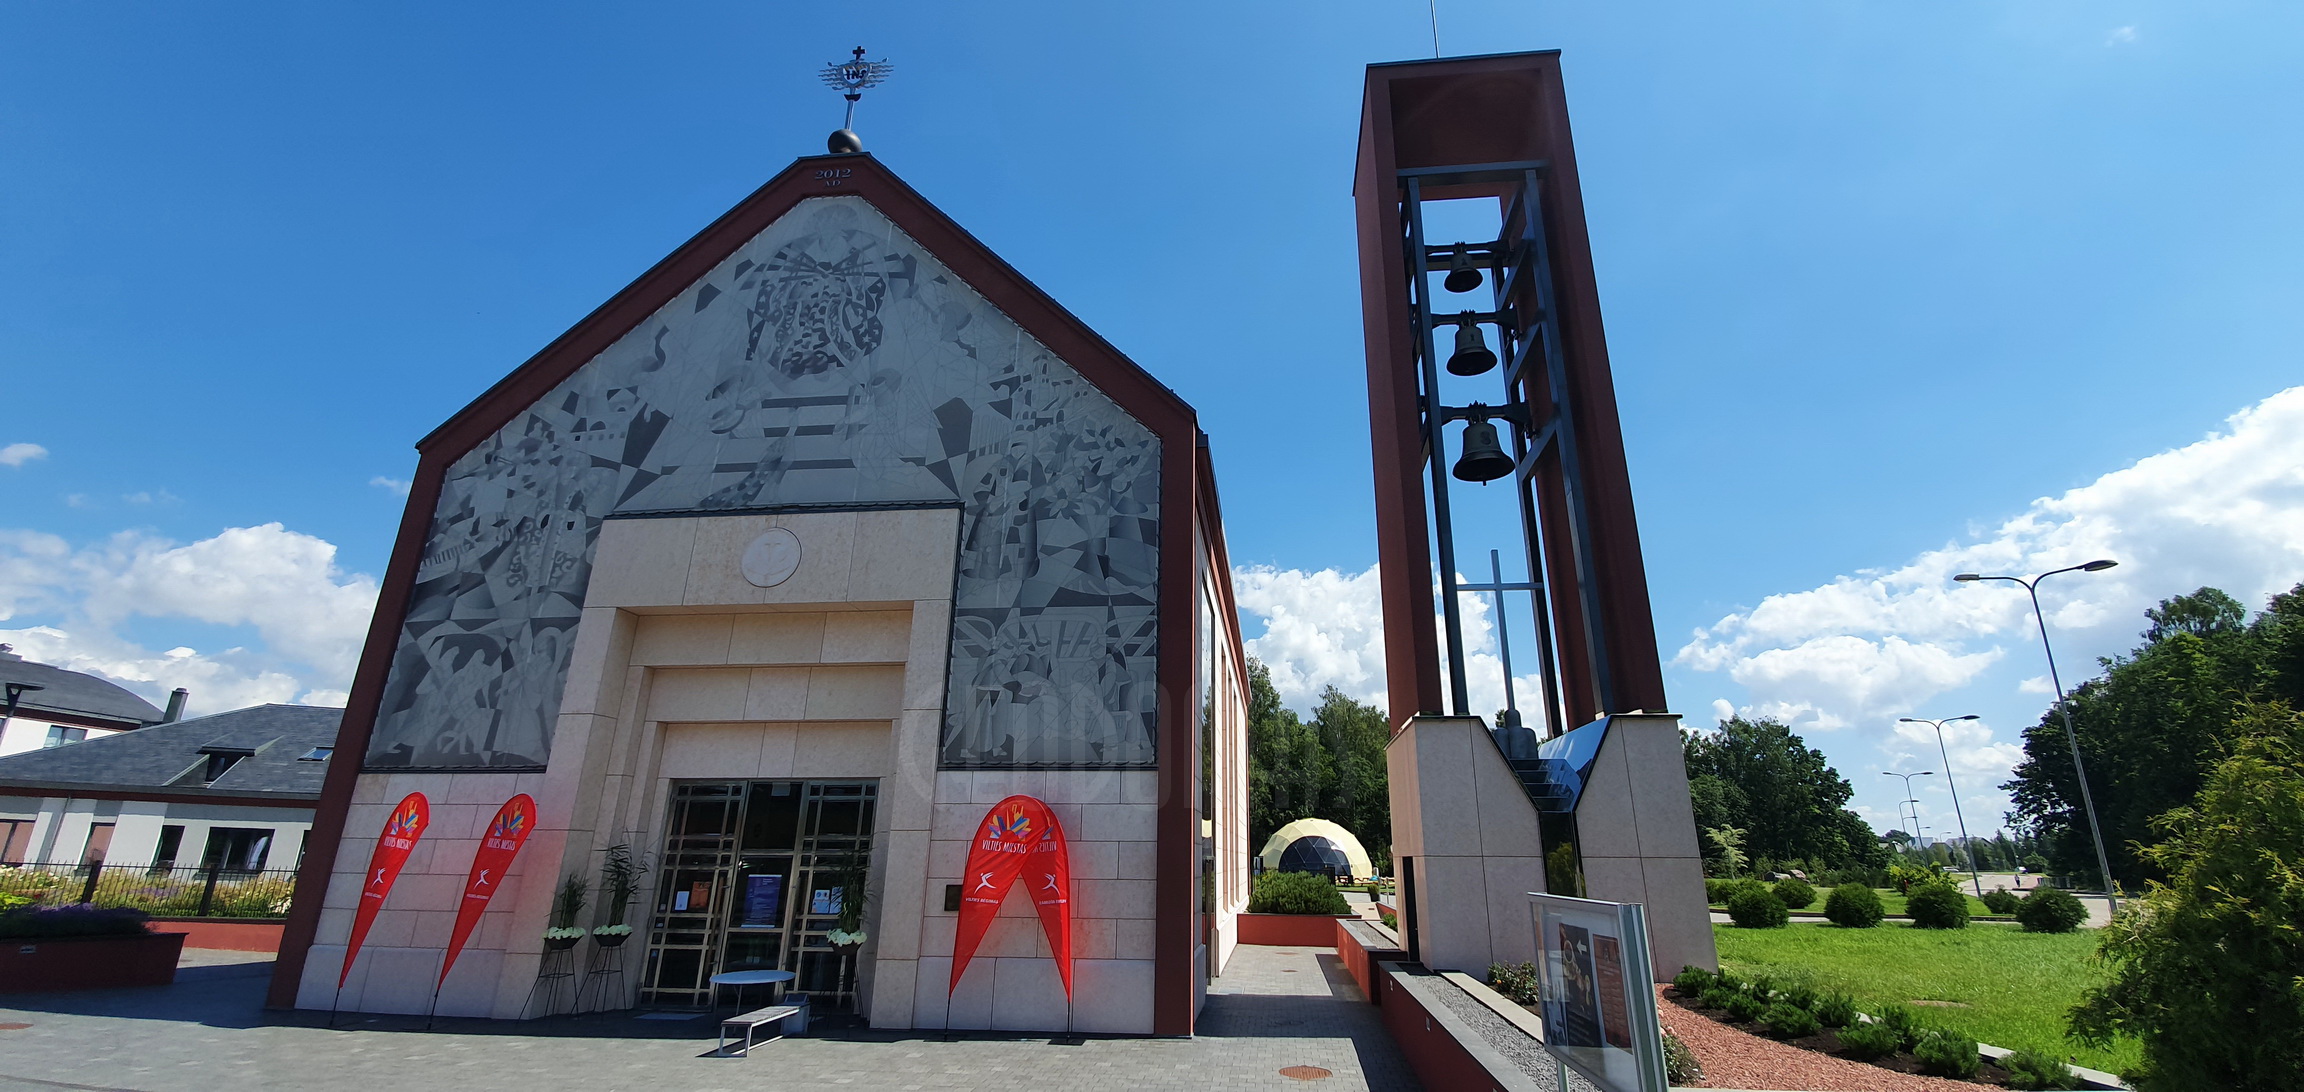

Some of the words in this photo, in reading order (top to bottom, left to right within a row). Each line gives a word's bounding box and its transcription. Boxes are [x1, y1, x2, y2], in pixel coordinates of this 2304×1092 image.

[815, 168, 852, 180] 2012
[982, 839, 1001, 851] VILTIES
[1003, 841, 1027, 854] MIESTAS
